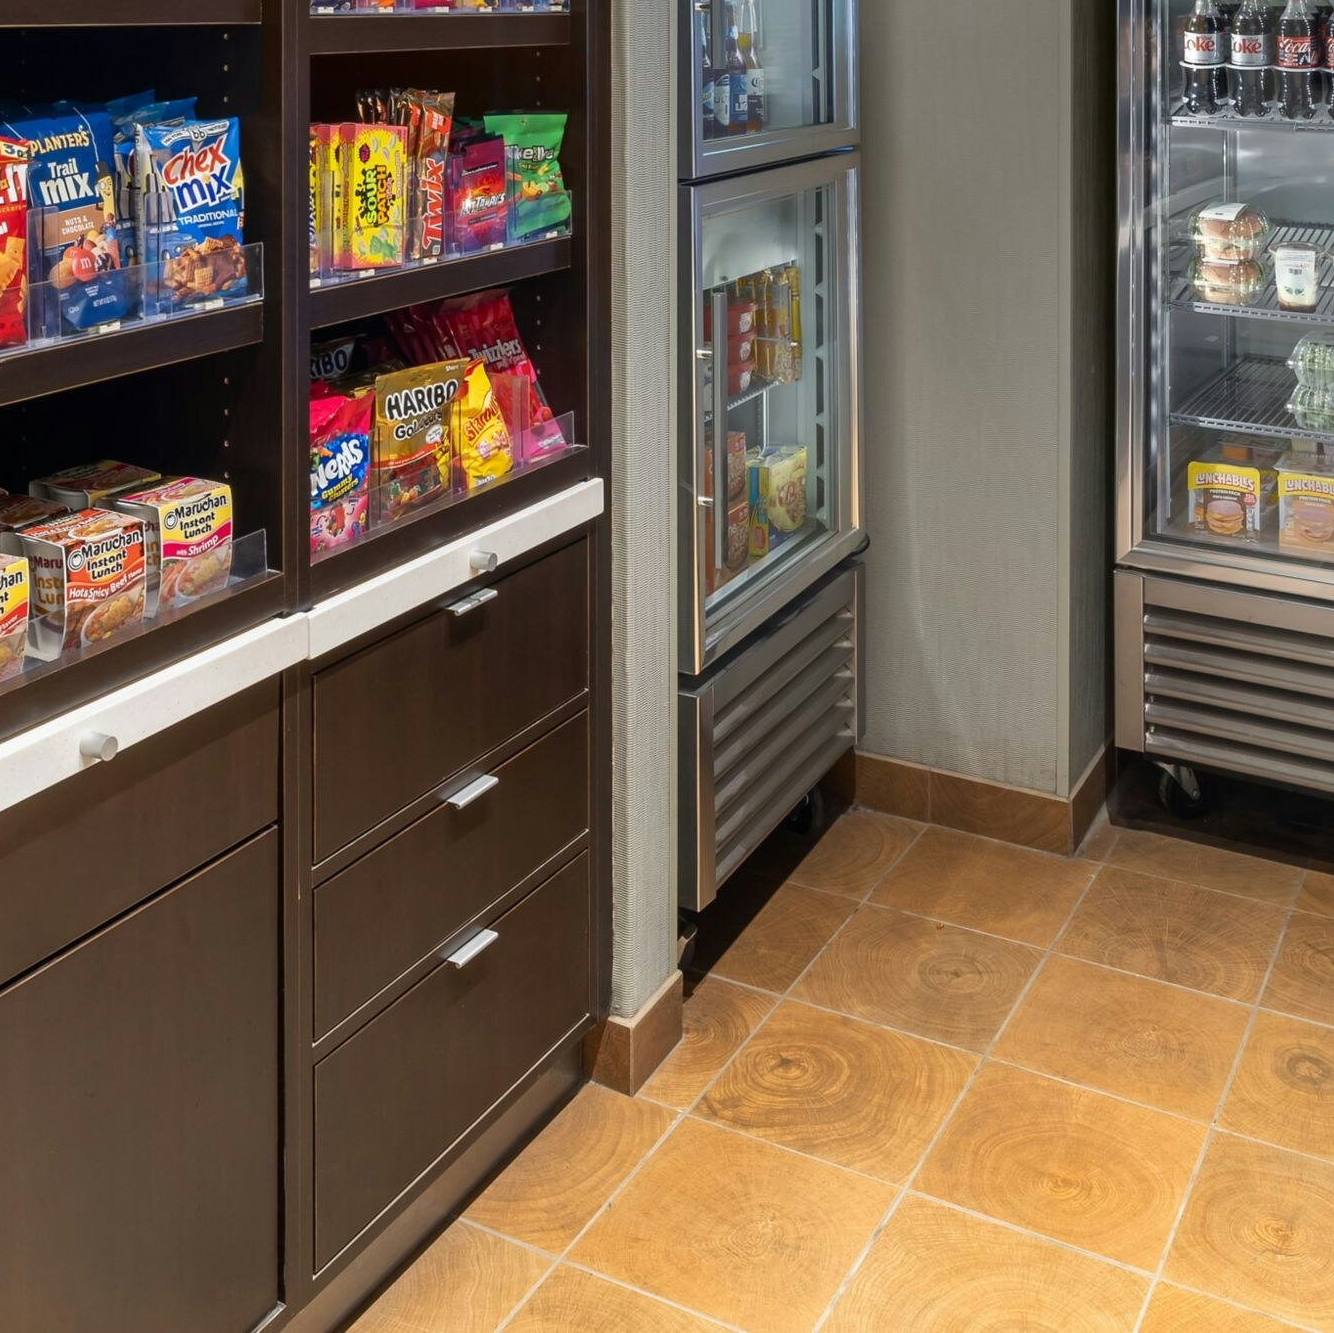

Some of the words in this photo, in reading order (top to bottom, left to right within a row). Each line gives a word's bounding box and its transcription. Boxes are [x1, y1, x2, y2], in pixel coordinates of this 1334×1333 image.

[48, 158, 79, 178] Trail
[164, 137, 227, 184] Chex
[39, 172, 96, 205] mix
[367, 169, 377, 224] SOUR
[377, 165, 388, 224] PATCH
[62, 222, 95, 235] CHOCOLATE
[179, 210, 238, 226] TRADITIONAL
[386, 379, 458, 420] HARIBO
[1195, 473, 1254, 492] LUNCHABLES
[174, 494, 227, 519] Maruchan
[180, 512, 215, 531] Instant
[184, 523, 212, 539] Lunch
[81, 530, 140, 559] Maruchan
[188, 535, 218, 556] Shrimp
[86, 549, 127, 572] Instant
[91, 562, 123, 581] Lunch
[110, 576, 128, 593] Beef
